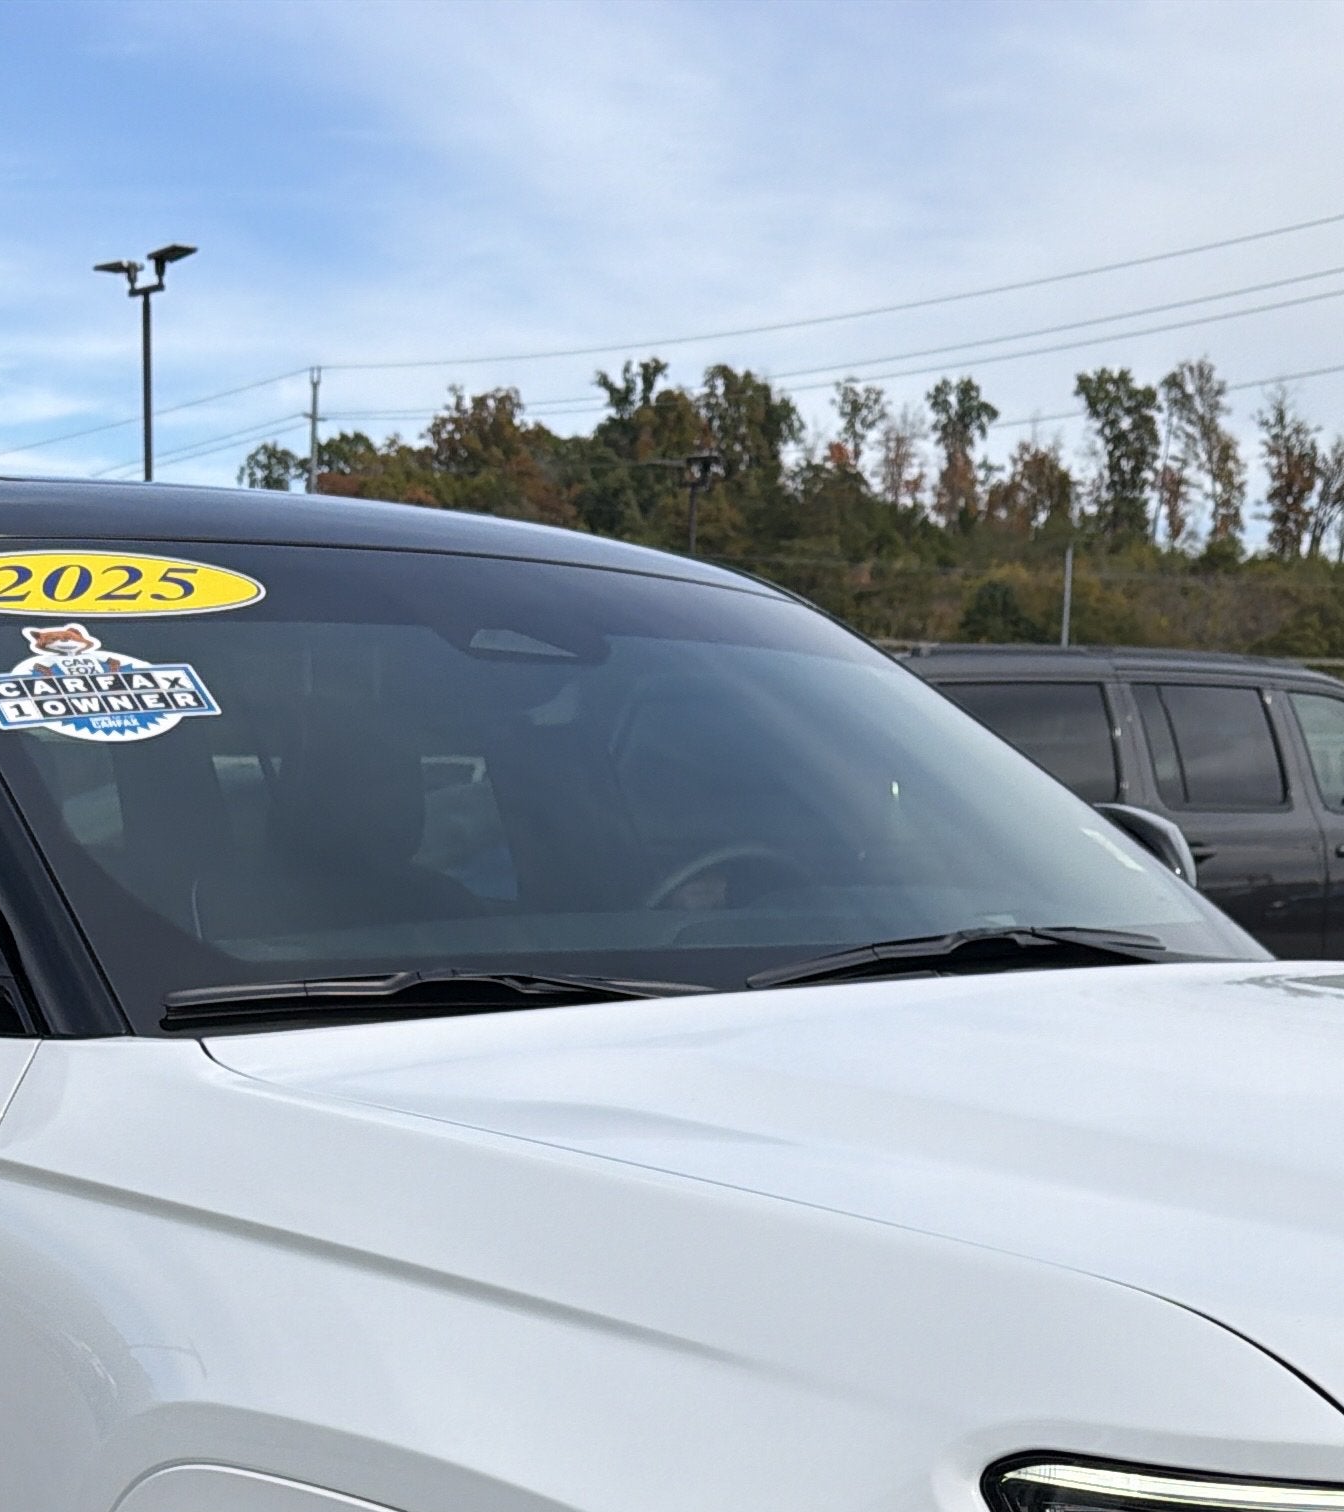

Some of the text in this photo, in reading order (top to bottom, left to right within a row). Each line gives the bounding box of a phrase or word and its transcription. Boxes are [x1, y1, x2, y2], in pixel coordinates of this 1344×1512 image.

[61, 657, 95, 667] CAR
[67, 666, 99, 675] FOX
[9, 692, 198, 719] 1 OWNER
